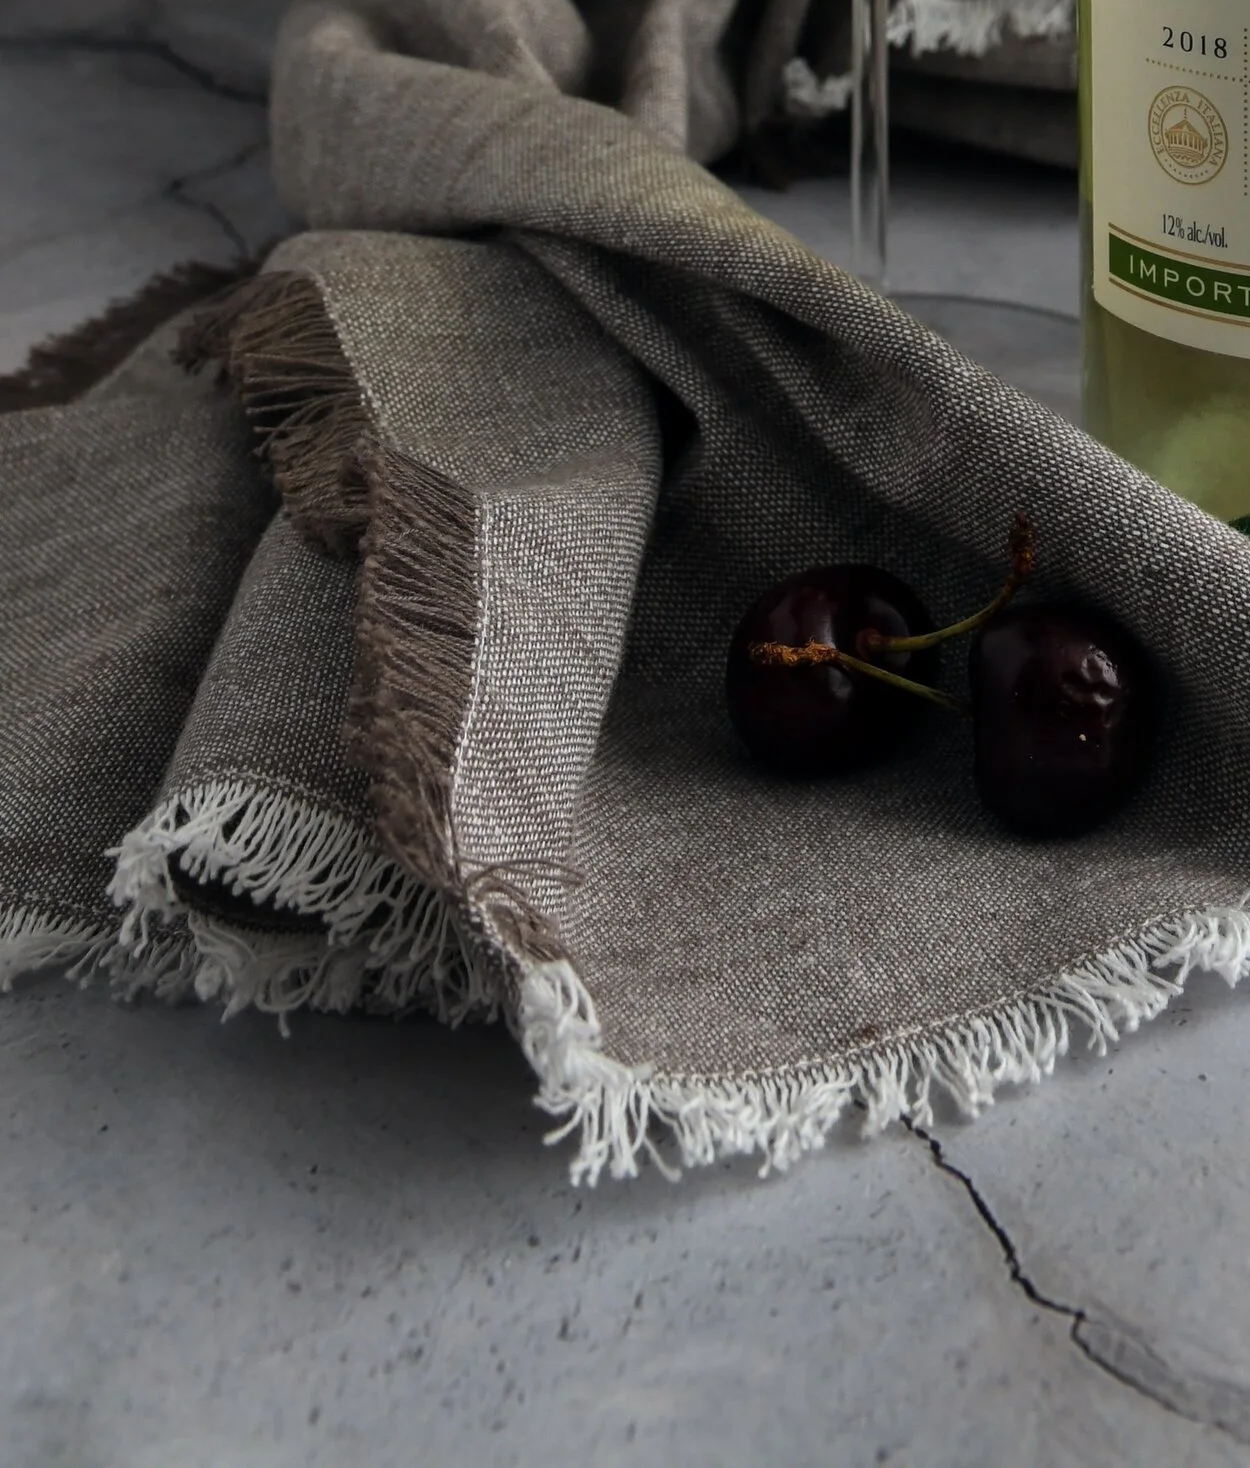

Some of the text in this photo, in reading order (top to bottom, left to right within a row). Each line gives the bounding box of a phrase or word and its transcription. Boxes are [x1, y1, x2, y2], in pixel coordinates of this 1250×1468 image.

[1162, 26, 1228, 59] 2018
[1152, 91, 1224, 166] ECCELLENZA ITALIANA
[1162, 214, 1185, 238] 12%
